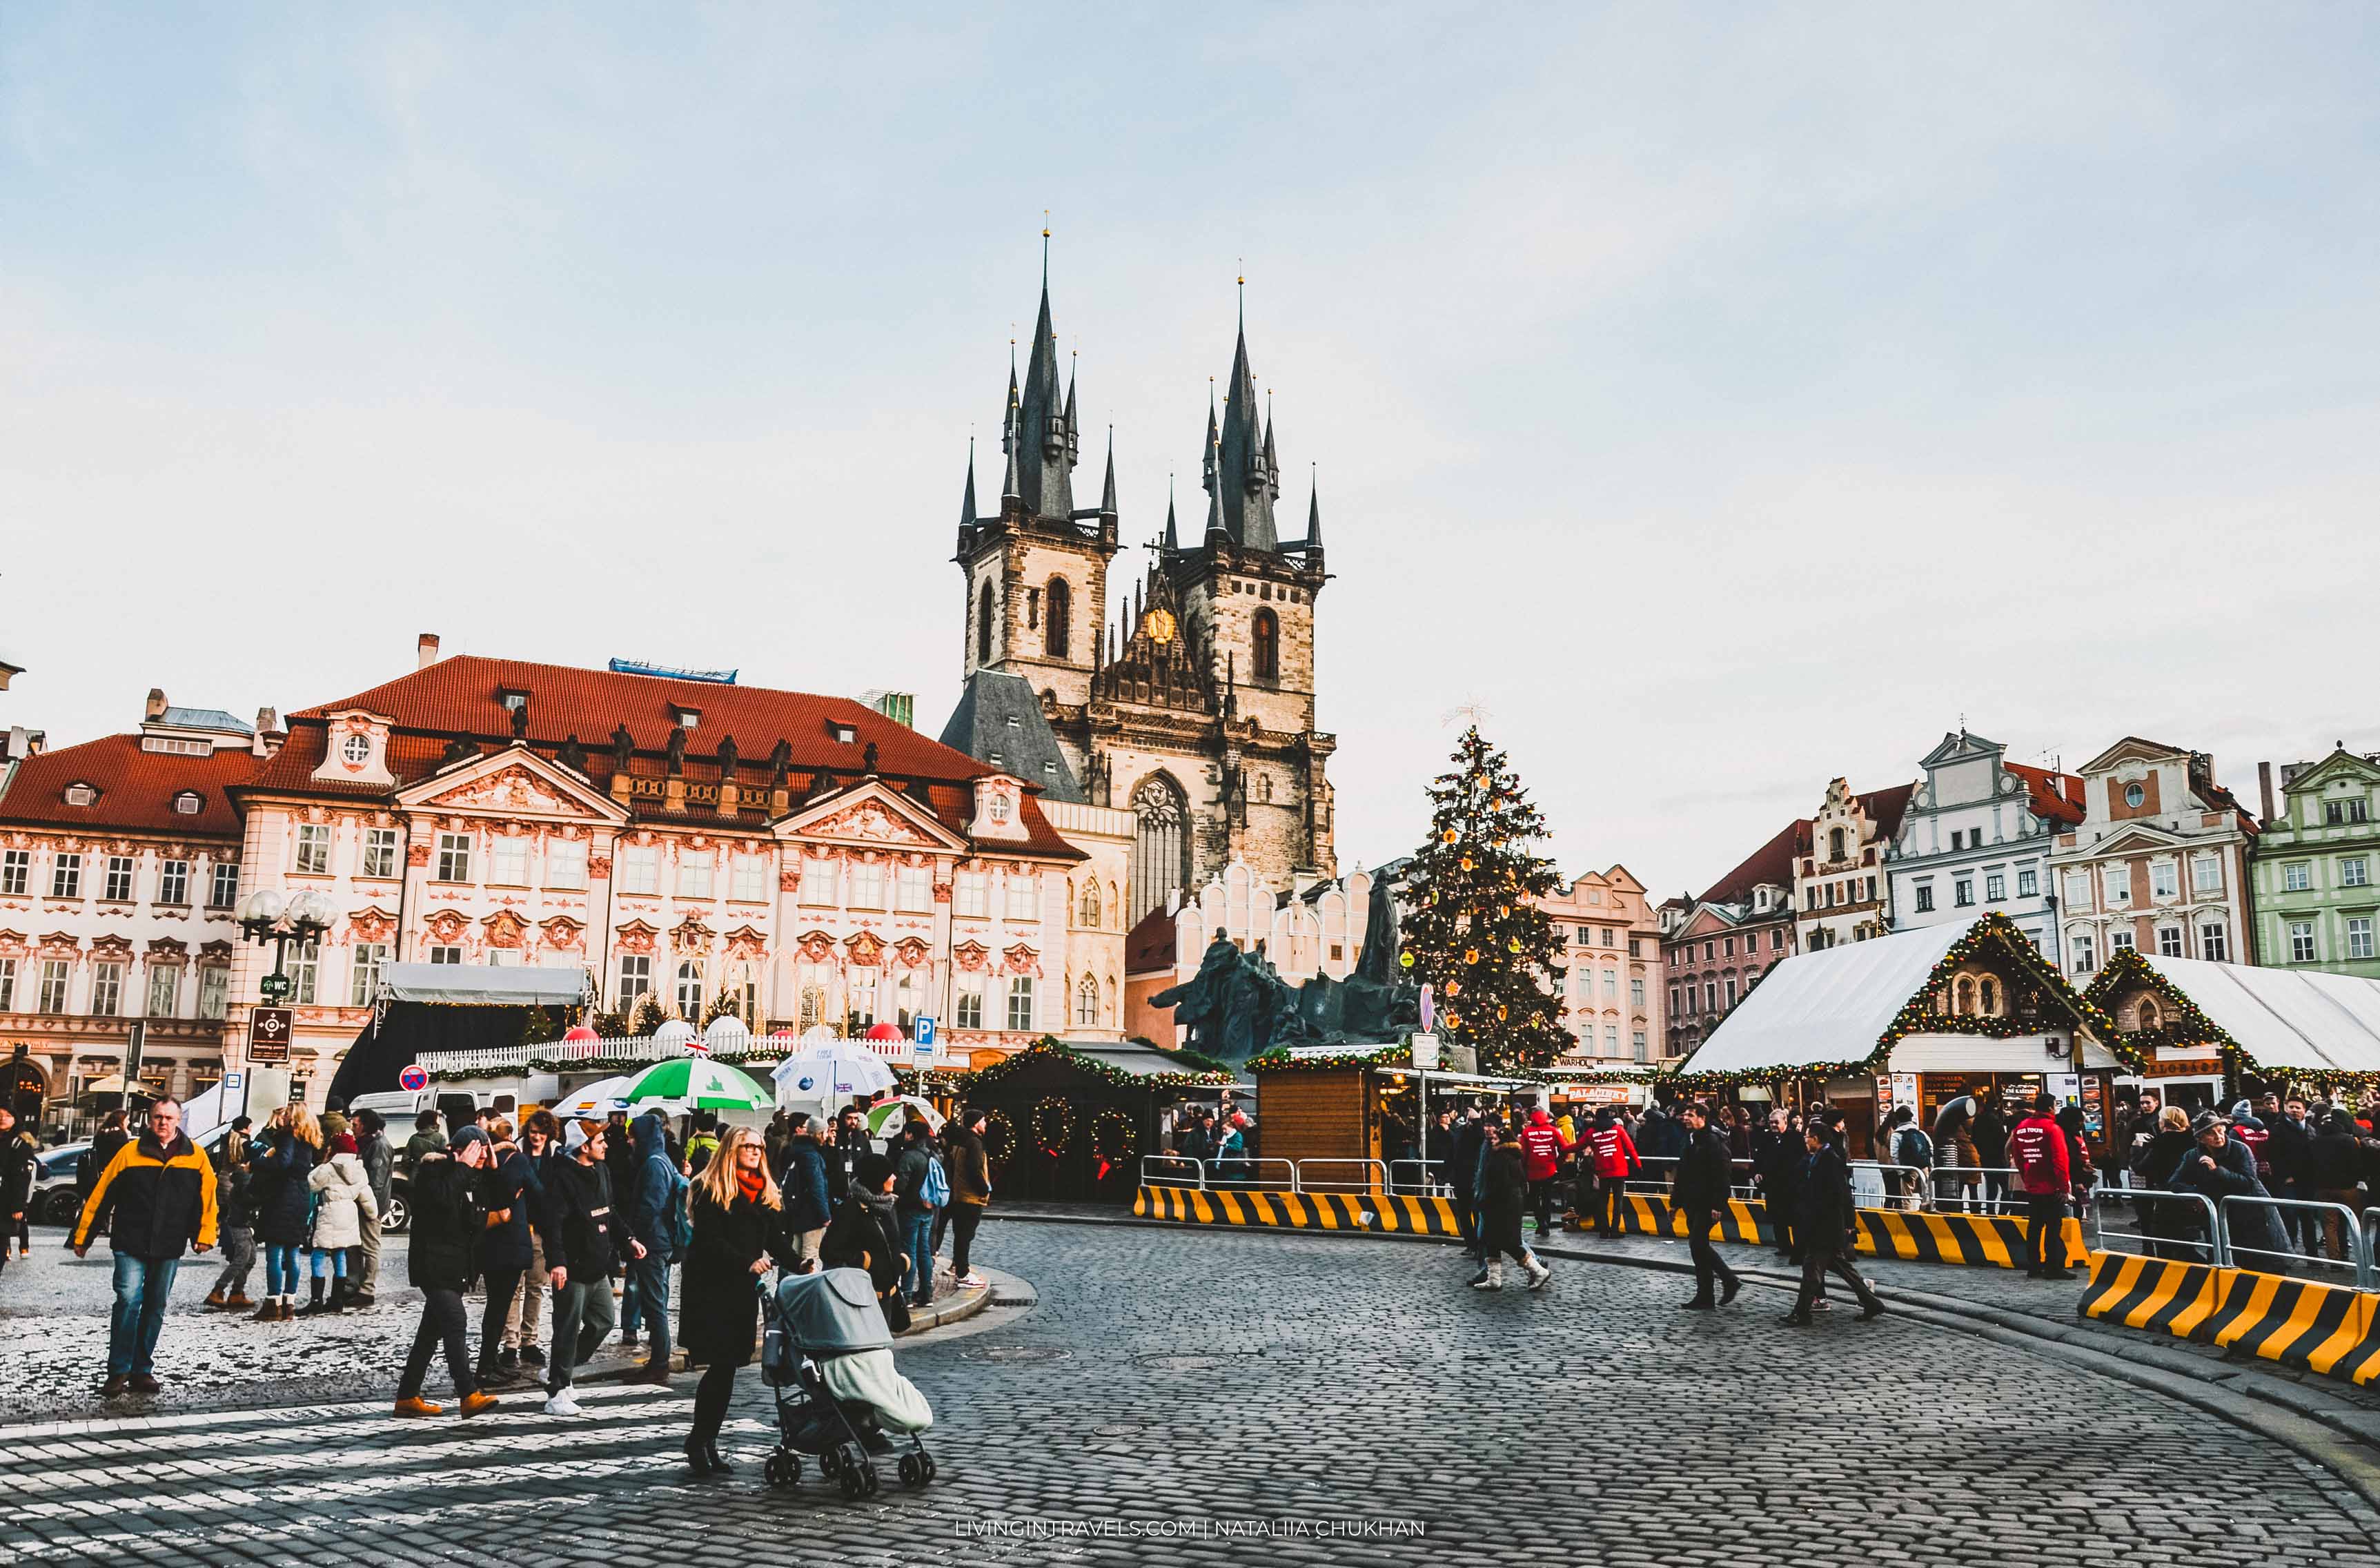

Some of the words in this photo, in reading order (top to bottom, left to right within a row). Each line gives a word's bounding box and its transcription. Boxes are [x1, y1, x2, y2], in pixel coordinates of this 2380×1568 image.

[274, 981, 286, 990] WC
[918, 1021, 931, 1041] P
[1560, 1057, 1590, 1066] WARHOL
